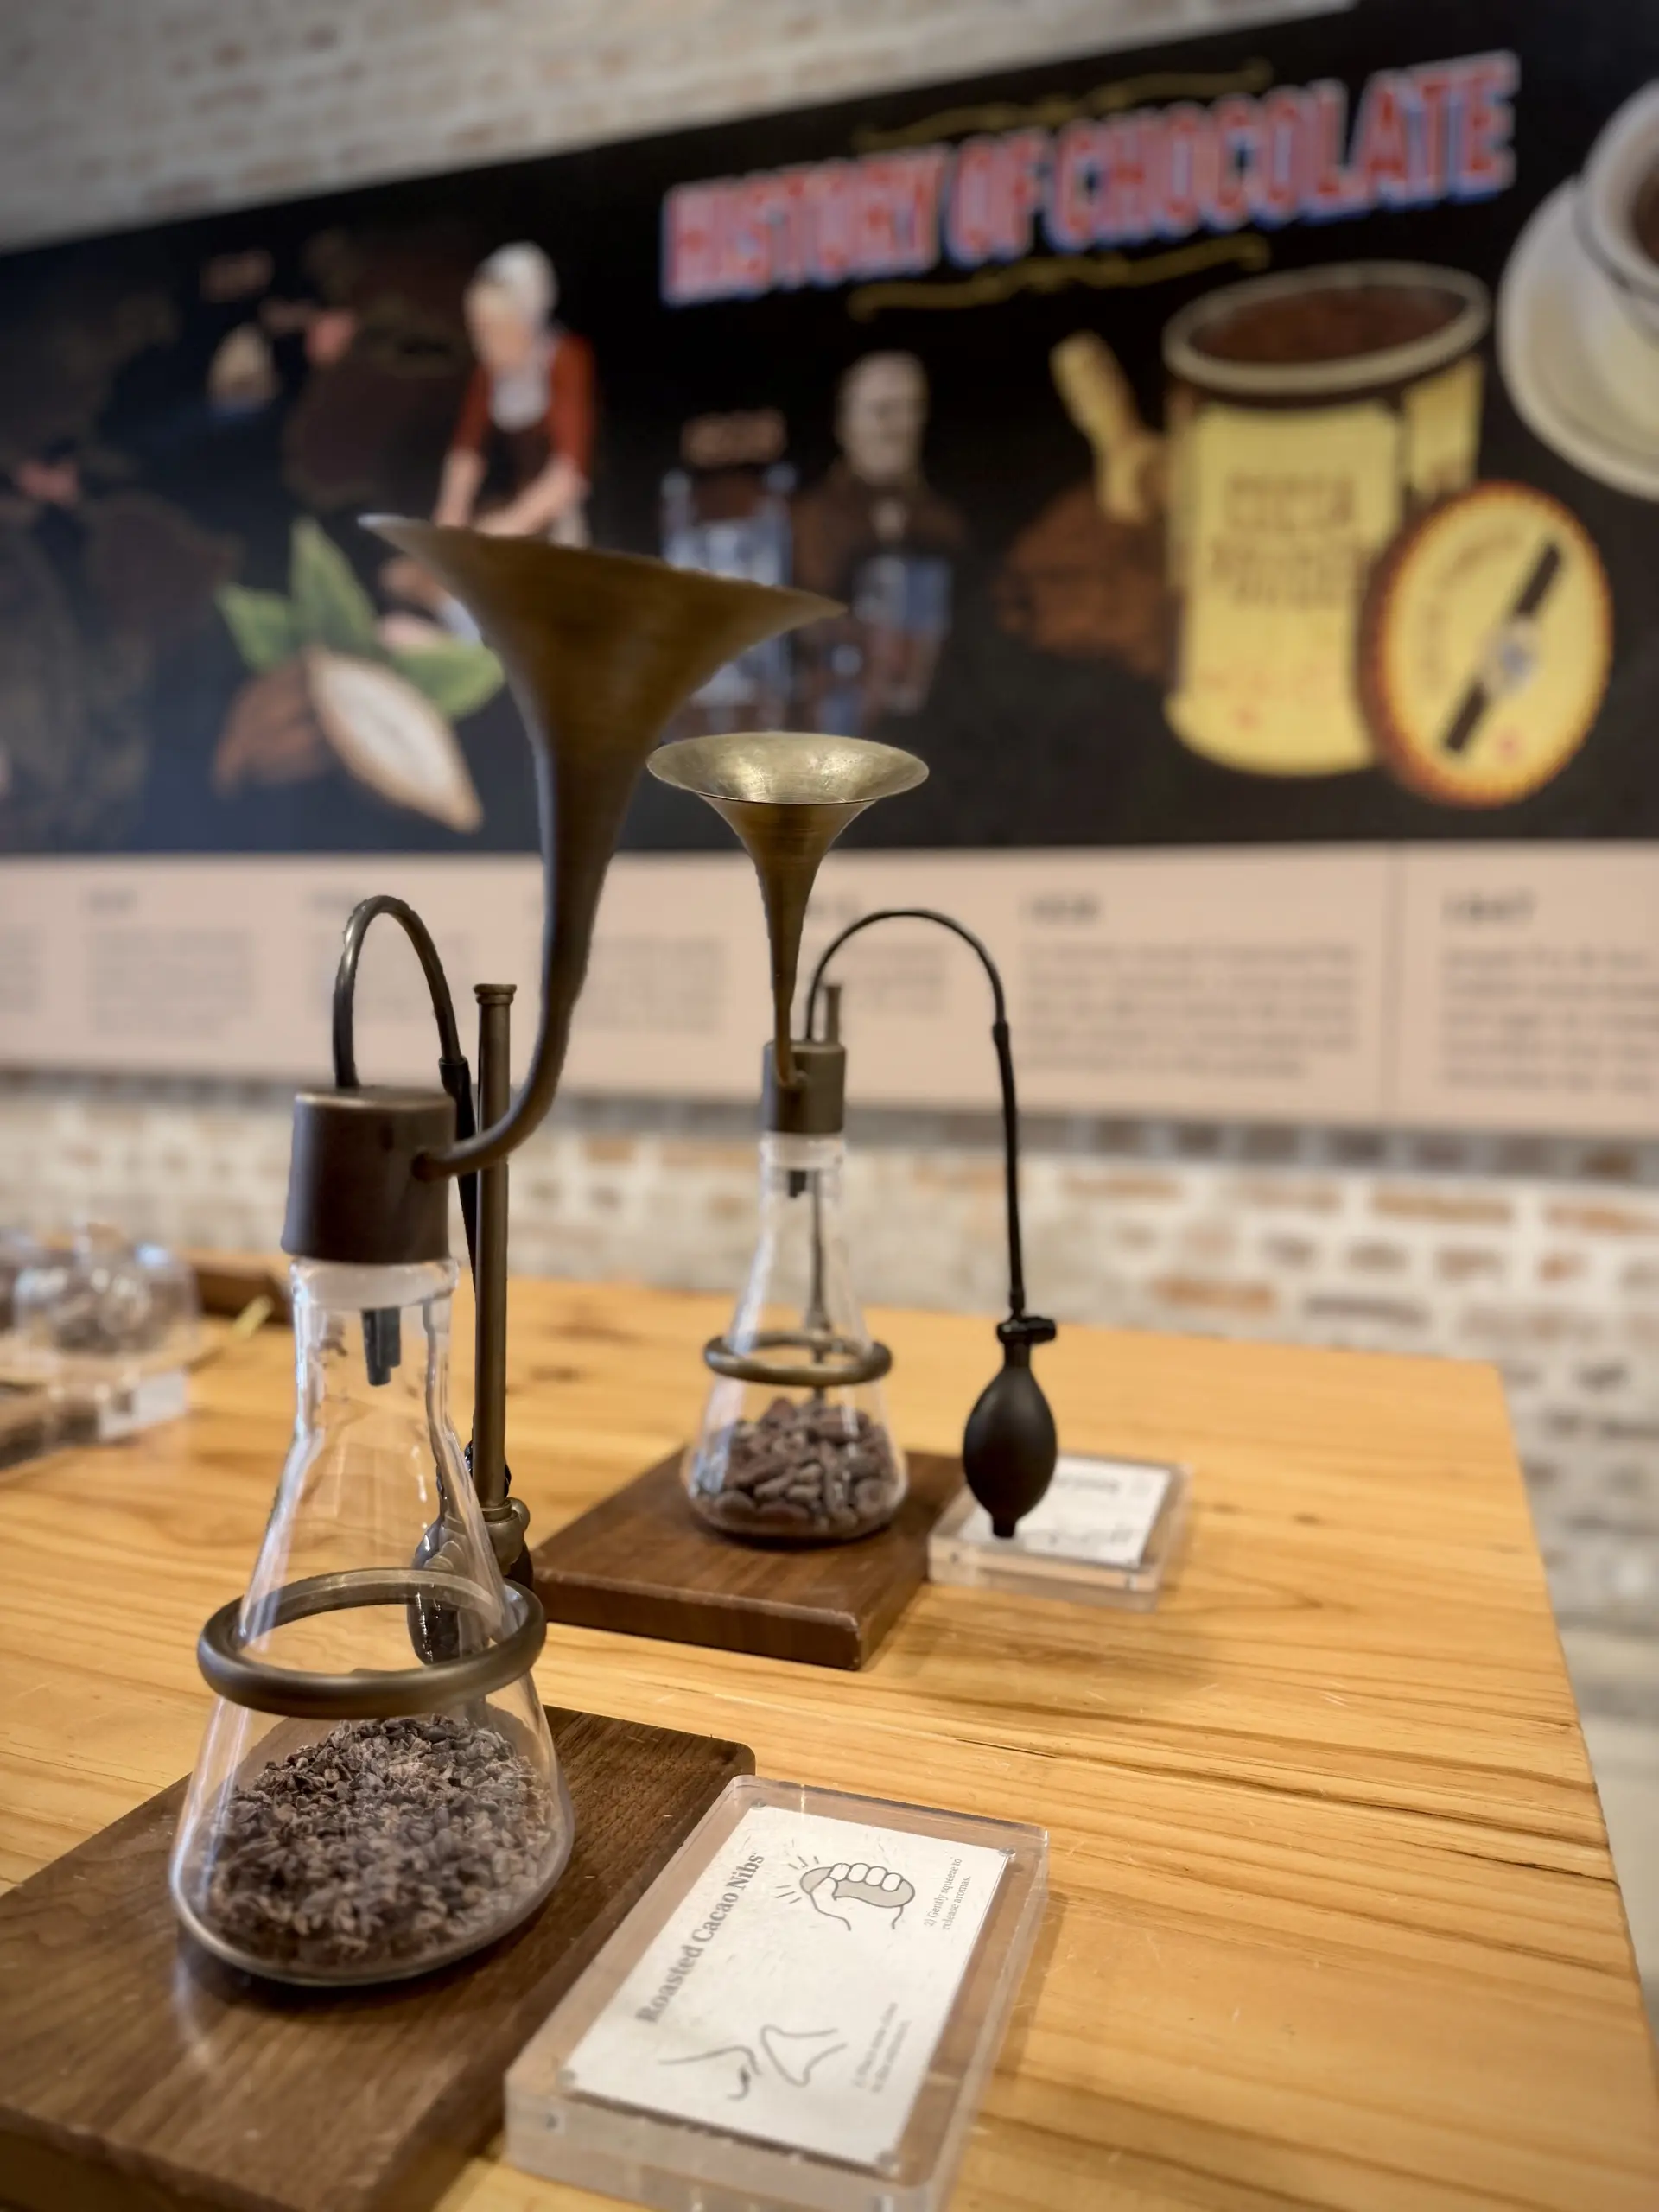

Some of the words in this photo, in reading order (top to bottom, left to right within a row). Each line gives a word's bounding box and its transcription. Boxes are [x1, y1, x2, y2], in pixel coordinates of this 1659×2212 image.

[663, 147, 948, 307] HISTORY
[947, 126, 1047, 266] OF
[1044, 49, 1521, 252] CHOCOLATE
[635, 1945, 705, 2023] Roasted
[691, 1891, 740, 1942] Cacao
[725, 1853, 765, 1891] Nibs
[926, 1893, 949, 1918] Gently
[940, 1866, 959, 1893] squeeze
[941, 1904, 959, 1930] release
[953, 1876, 972, 1904] aromas.
